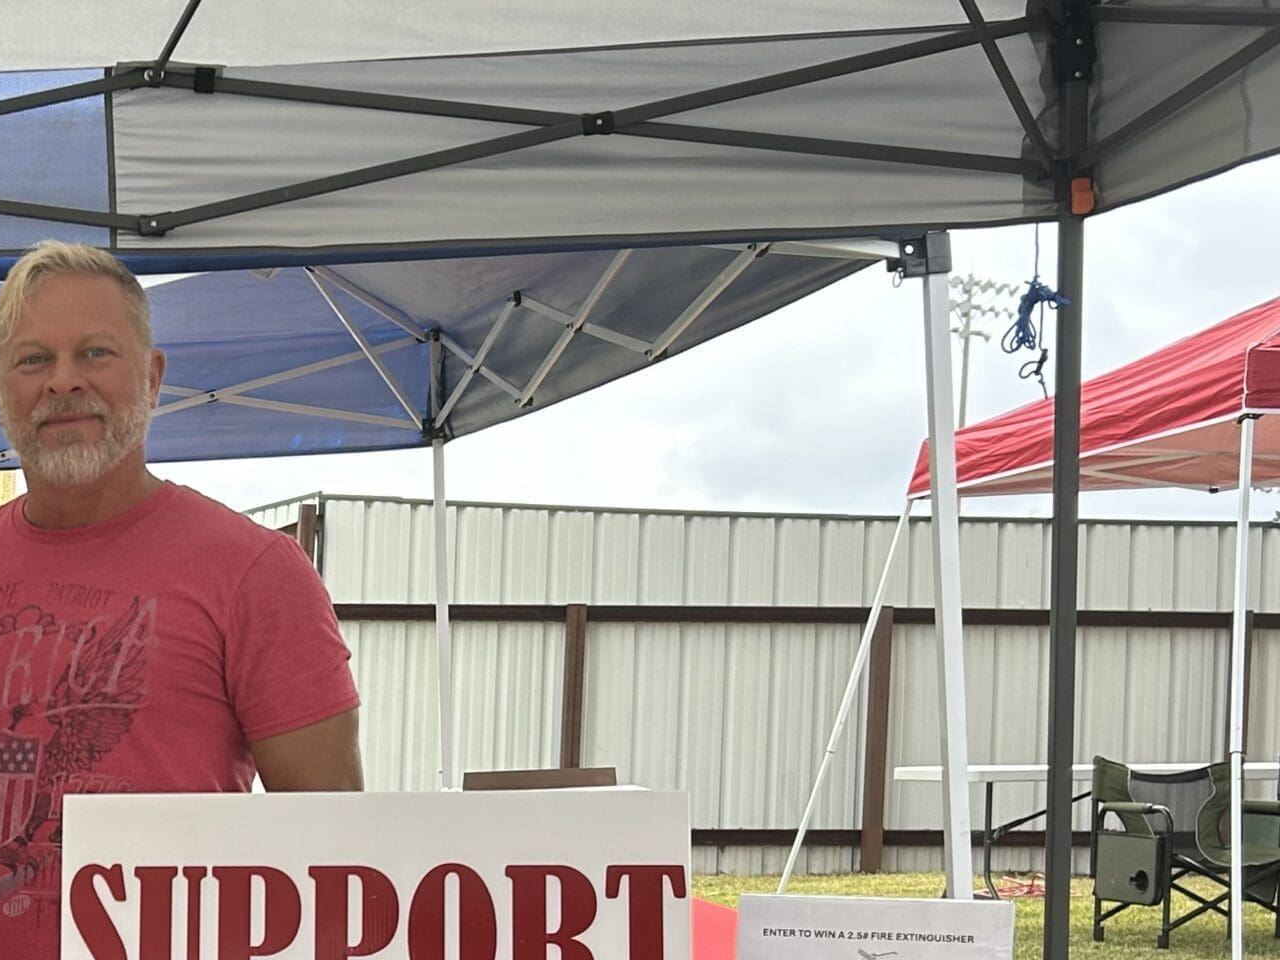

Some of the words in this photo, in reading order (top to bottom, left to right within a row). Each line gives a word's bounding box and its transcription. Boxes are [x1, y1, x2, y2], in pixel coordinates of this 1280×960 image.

[763, 928, 796, 938] ENTER
[799, 929, 812, 938] TO
[814, 930, 837, 939] WIN
[838, 931, 845, 939] A
[871, 932, 894, 941] FIRE
[896, 933, 975, 944] EXTINGUISHER
